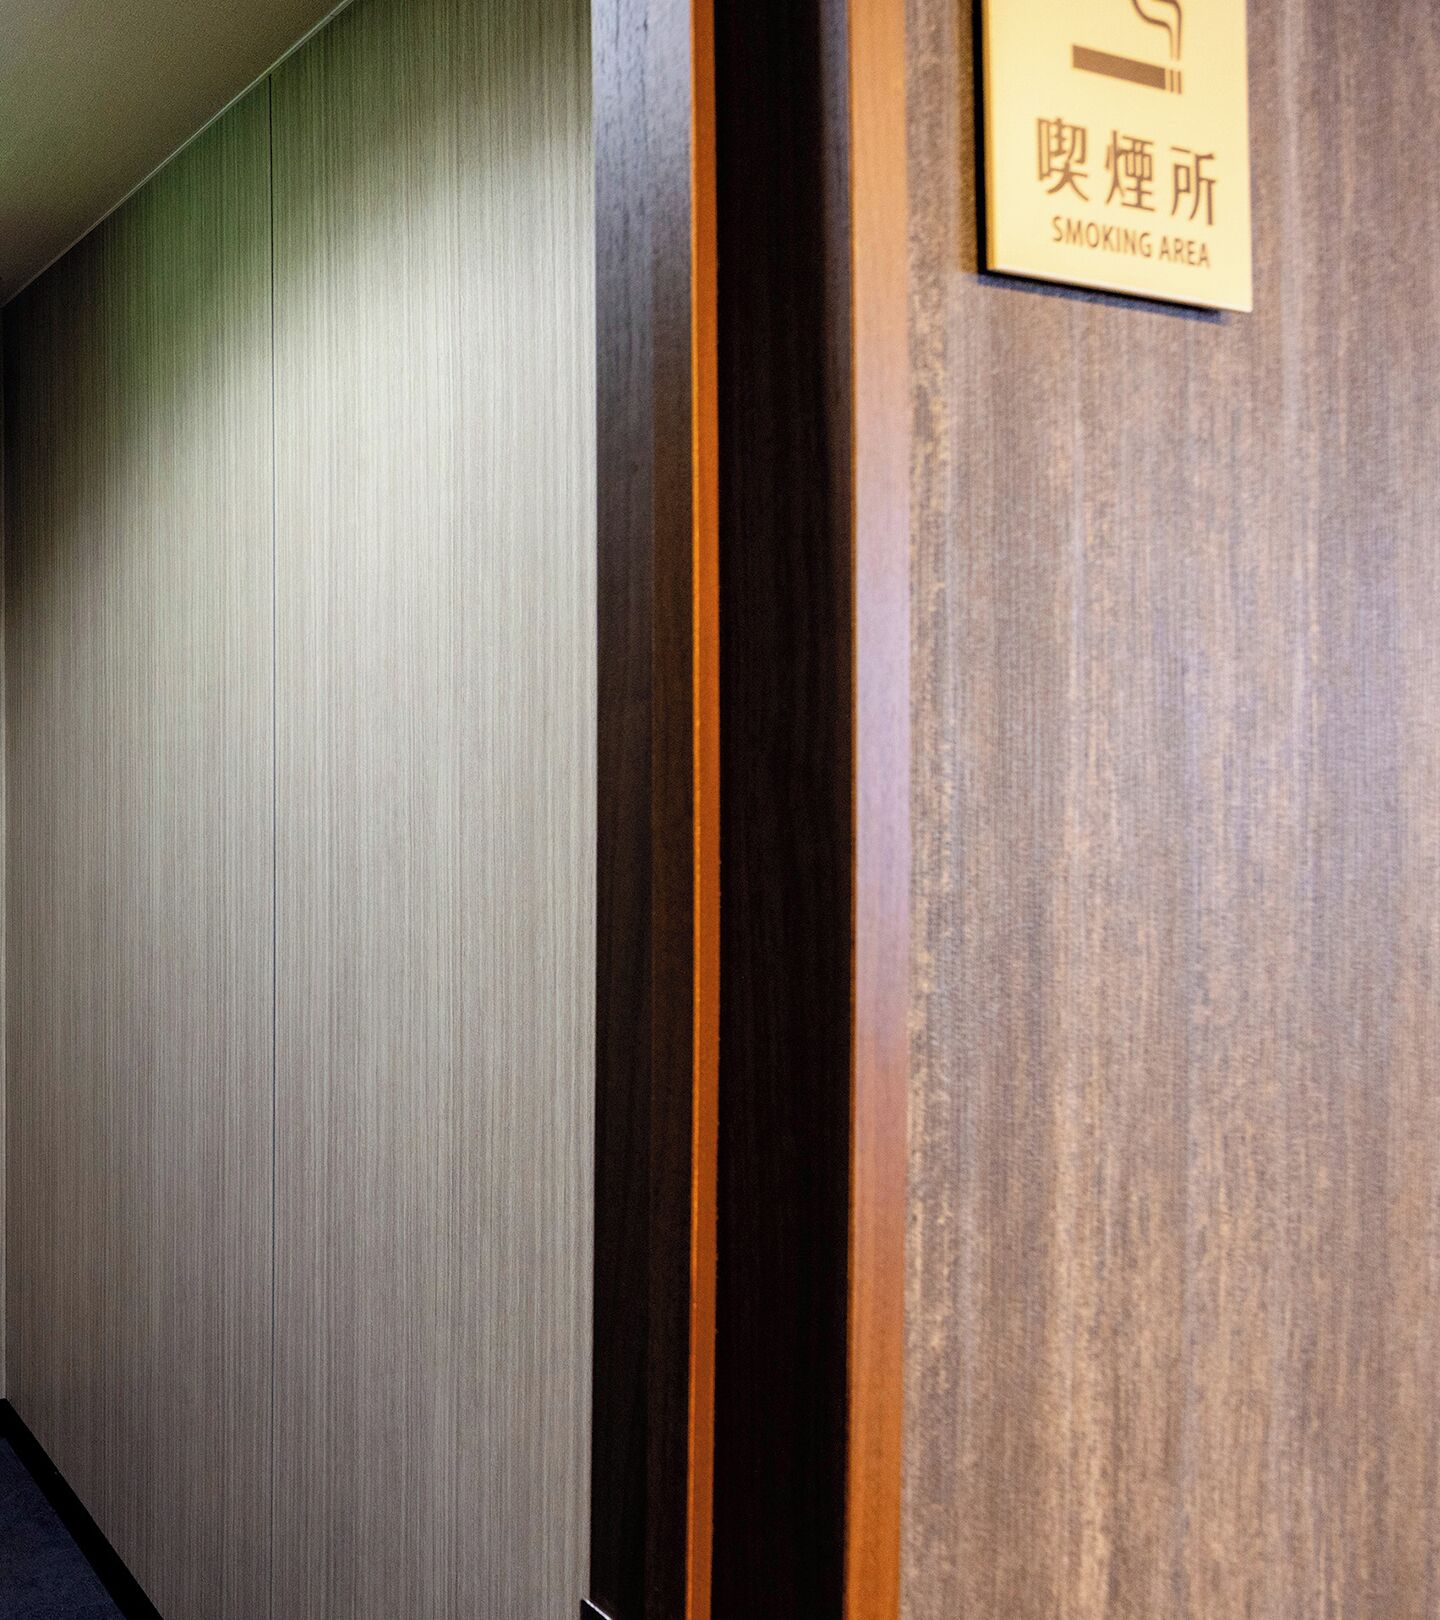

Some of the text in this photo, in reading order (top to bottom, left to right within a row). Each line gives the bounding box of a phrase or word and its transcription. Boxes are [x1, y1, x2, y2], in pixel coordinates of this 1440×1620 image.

[1037, 117, 1218, 226] 喫煙所
[1052, 215, 1210, 268] SMOKING AREA
